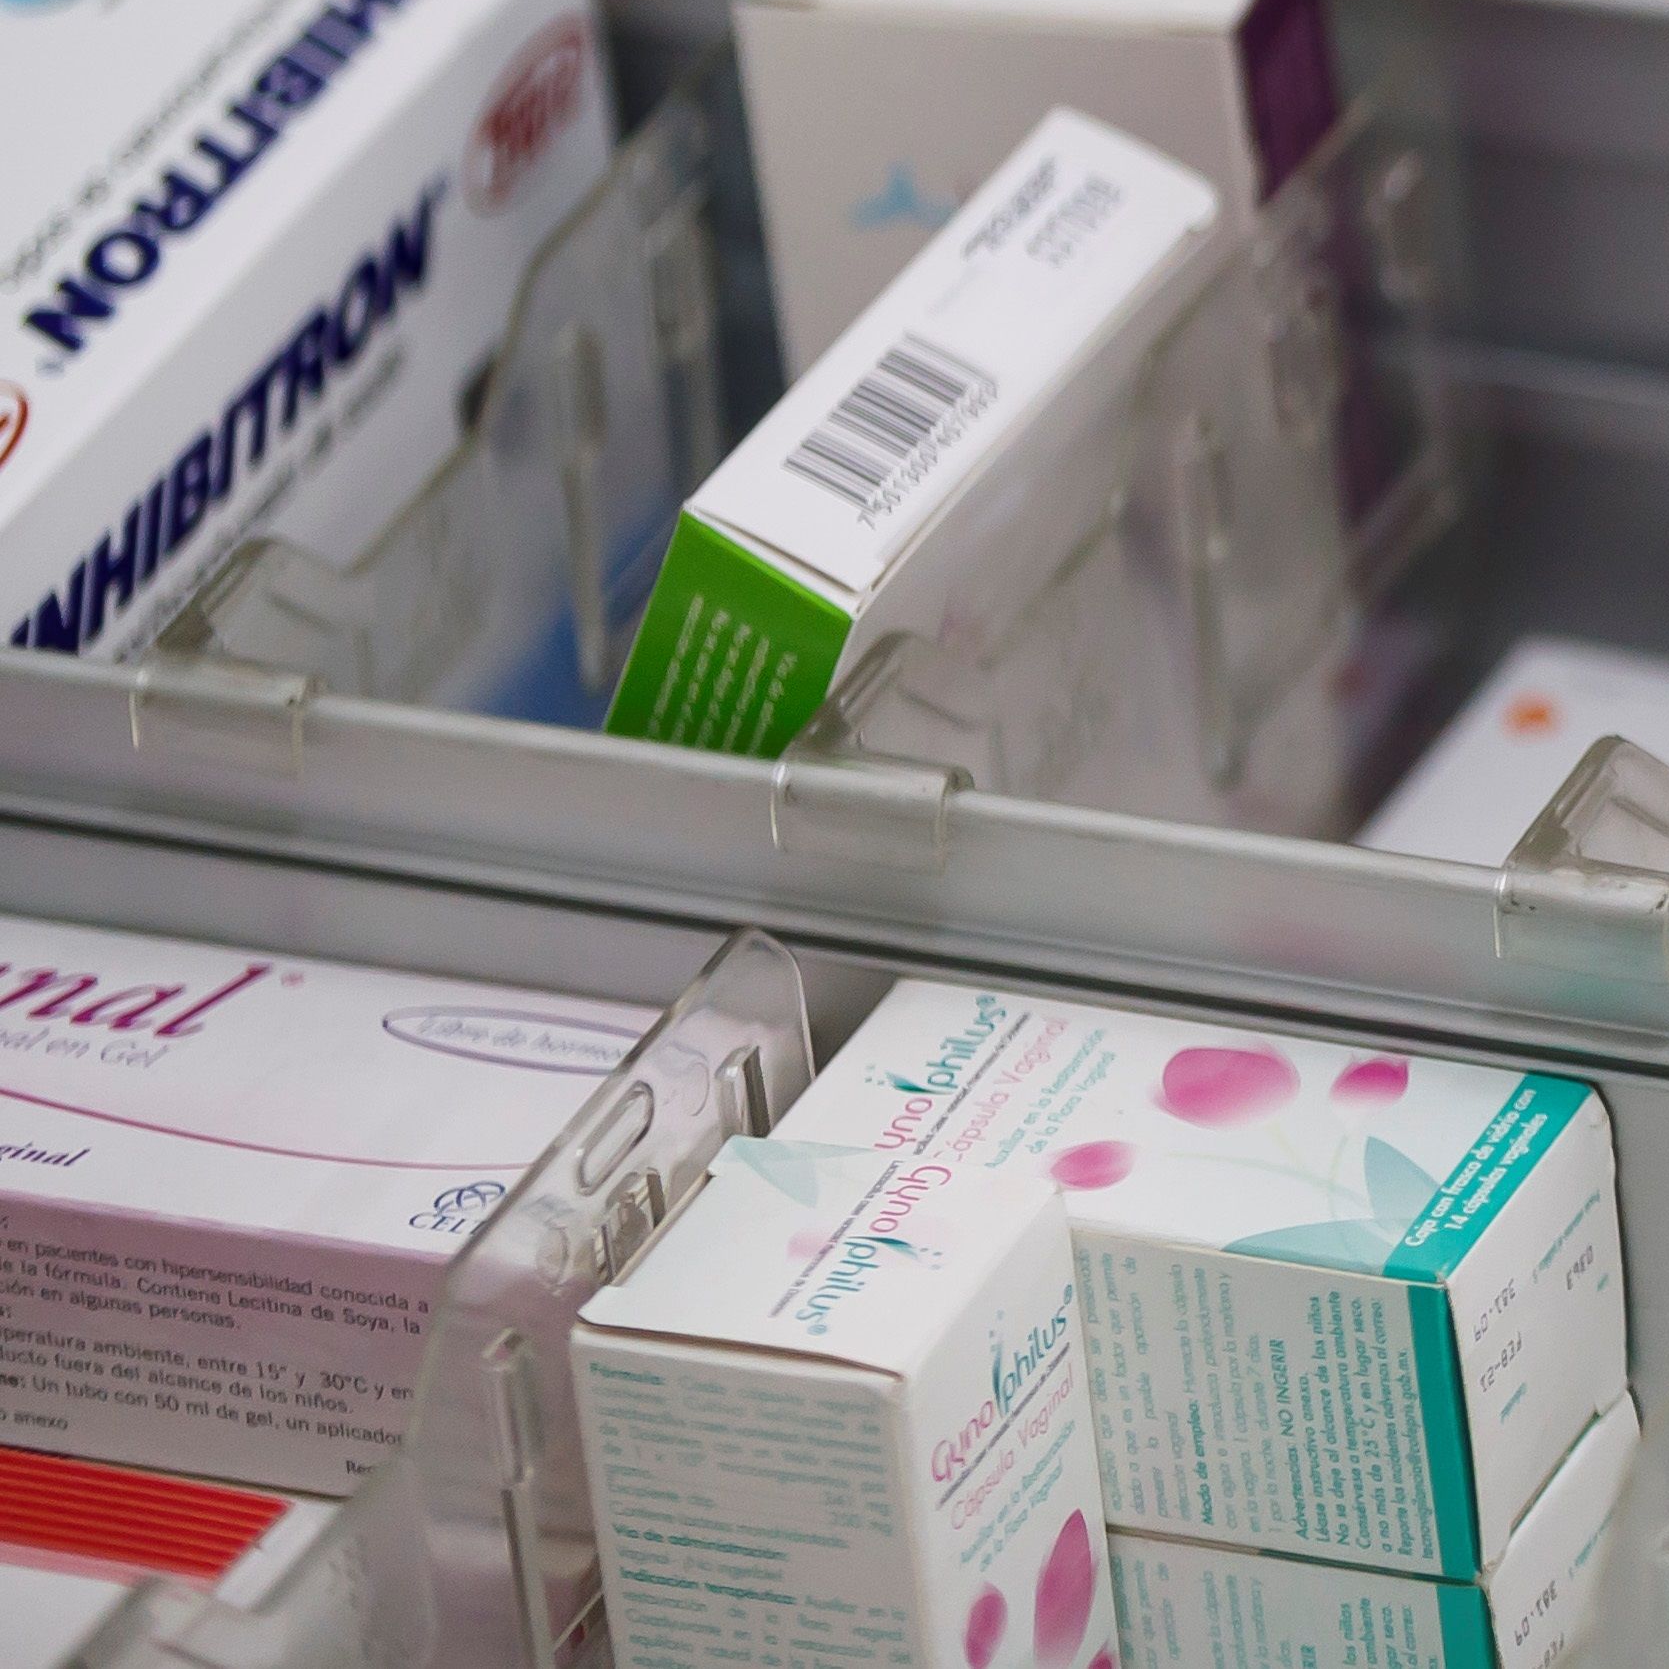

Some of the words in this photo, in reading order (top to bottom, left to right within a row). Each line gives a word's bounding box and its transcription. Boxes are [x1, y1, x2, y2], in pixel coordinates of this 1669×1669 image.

[10, 191, 440, 657] NHIBITRON
[0, 962, 272, 1039] nal
[1513, 1088, 1537, 1112] con
[1485, 1110, 1521, 1145] vidrio
[1470, 1143, 1496, 1162] de
[1440, 1160, 1482, 1196] frasco
[1444, 1213, 1470, 1231] 14
[1462, 1166, 1508, 1216] cápsulas
[1499, 1113, 1549, 1166] vaginales
[1431, 1196, 1455, 1219] con
[1404, 1217, 1439, 1247] Caja
[7, 1238, 29, 1253] en
[35, 1242, 119, 1268] pacientes
[124, 1256, 156, 1273] con
[161, 1257, 313, 1296] hipersensibilidad
[320, 1284, 409, 1311] conocida
[417, 1298, 429, 1314] a
[20, 1259, 38, 1277] la
[136, 1276, 221, 1306] Contiene
[228, 1289, 302, 1317] Lecitina
[310, 1304, 335, 1322] de
[343, 1306, 395, 1333] Soya,
[403, 1316, 421, 1335] la
[41, 1286, 62, 1303] en
[69, 1289, 143, 1313] algunas
[1306, 1296, 1324, 1335] niños
[1327, 1290, 1348, 1359] ambiente
[1310, 1339, 1326, 1360] los
[1352, 1338, 1372, 1377] lugar
[1370, 1346, 1387, 1359] al
[54, 1352, 105, 1376] fuera
[110, 1363, 141, 1381] del
[148, 1369, 223, 1395] alcance
[229, 1381, 252, 1399] de
[259, 1383, 289, 1405] los
[92, 1339, 191, 1369] ambiente,
[197, 1356, 248, 1376] entre
[294, 1371, 307, 1388] y
[372, 1382, 385, 1401] y
[1269, 1339, 1291, 1405] INGERIR
[1311, 1365, 1330, 1384] de
[33, 1374, 60, 1394] Un
[65, 1380, 109, 1403] tubo
[114, 1389, 149, 1408] con
[154, 1392, 181, 1413] 50
[185, 1399, 210, 1417] ml
[215, 1401, 240, 1421] de
[285, 1417, 310, 1432] un
[1336, 1361, 1361, 1452] temperatura
[1360, 1382, 1372, 1399] en
[14, 1409, 69, 1432] anexo
[1276, 1409, 1295, 1437] NO
[1319, 1388, 1337, 1445] alcance
[1192, 1461, 1208, 1480] de
[1303, 1427, 1324, 1498] instructivo
[1322, 1447, 1340, 1463] al
[1384, 1422, 1402, 1484] incidentes
[1327, 1468, 1347, 1499] deje
[1364, 1463, 1383, 1483] de
[1197, 1483, 1214, 1526] Modo
[1335, 1503, 1346, 1518] se
[1370, 1487, 1386, 1516] más
[1314, 1502, 1330, 1543] Léase
[1336, 1522, 1350, 1546] No
[1378, 1519, 1390, 1539] no
[1360, 1598, 1378, 1665] ambiente
